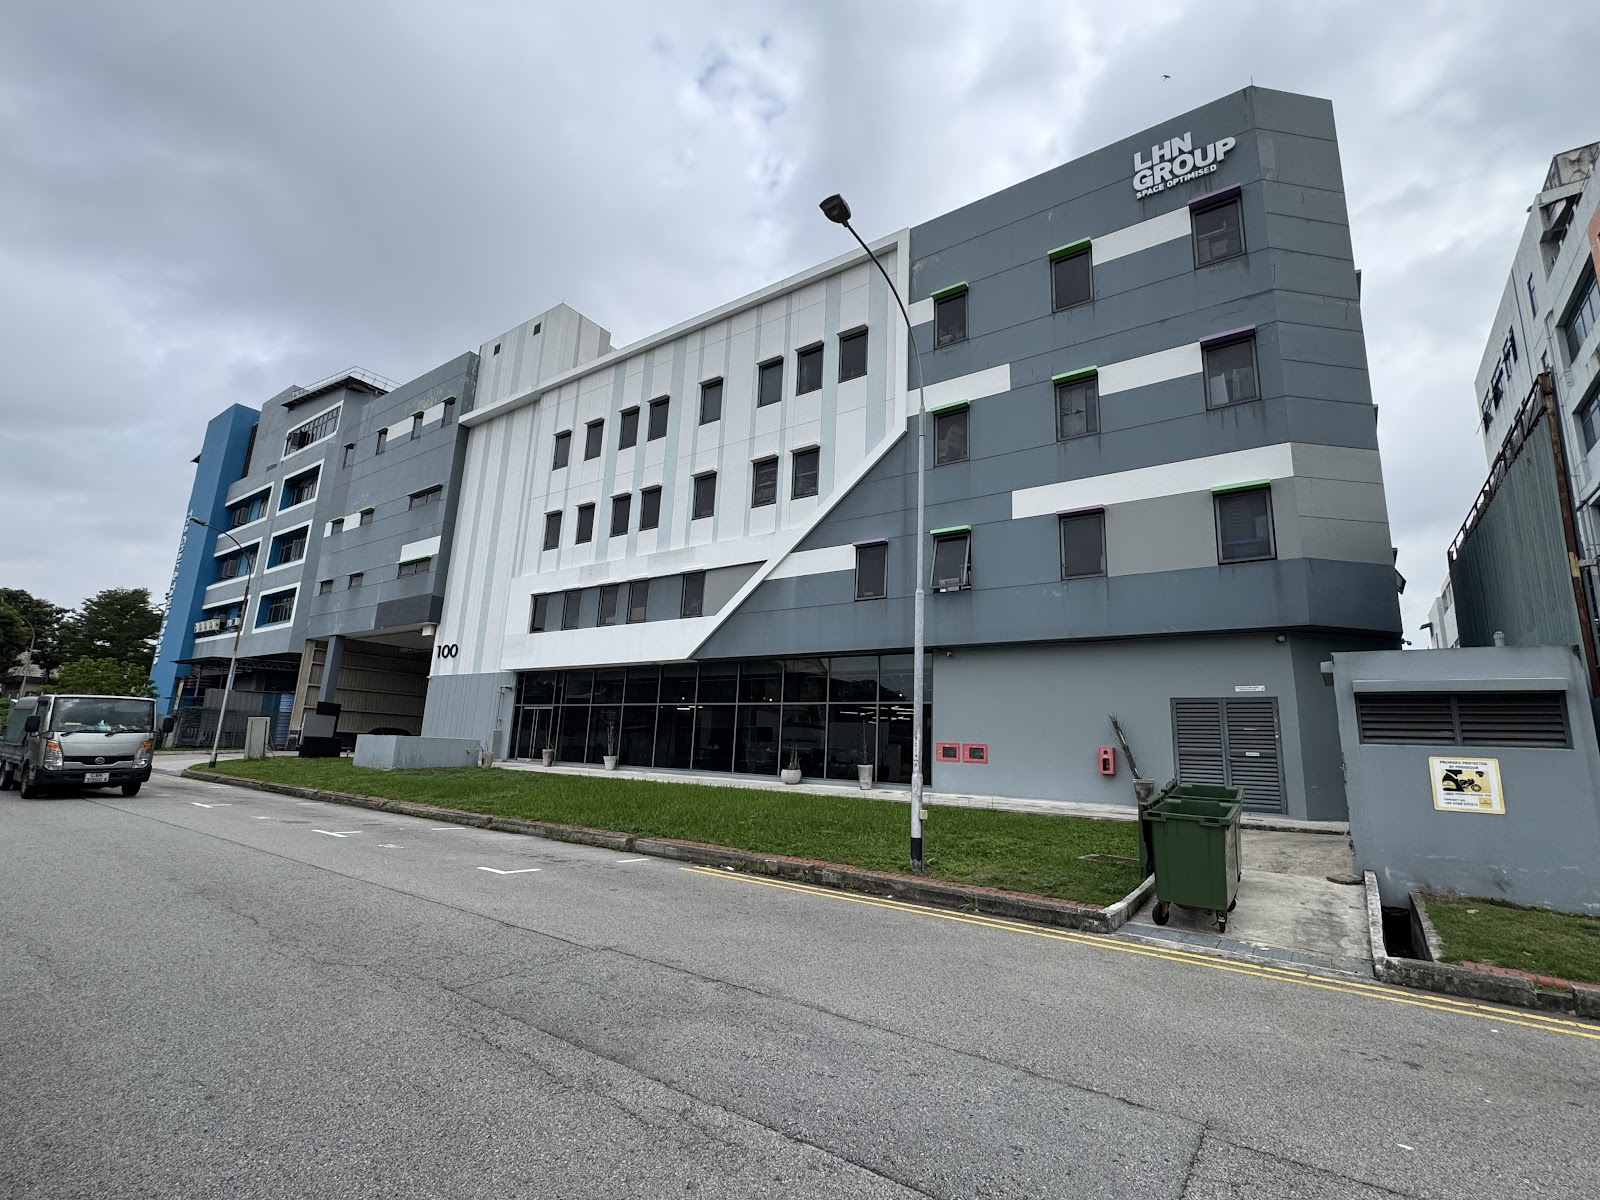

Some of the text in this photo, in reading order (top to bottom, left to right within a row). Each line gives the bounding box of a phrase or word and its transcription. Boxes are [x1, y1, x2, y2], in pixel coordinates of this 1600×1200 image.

[1132, 136, 1236, 191] GROUP
[1133, 132, 1192, 172] LHN
[1136, 164, 1217, 199] SPACE OPTIMISED
[437, 643, 459, 659] 100
